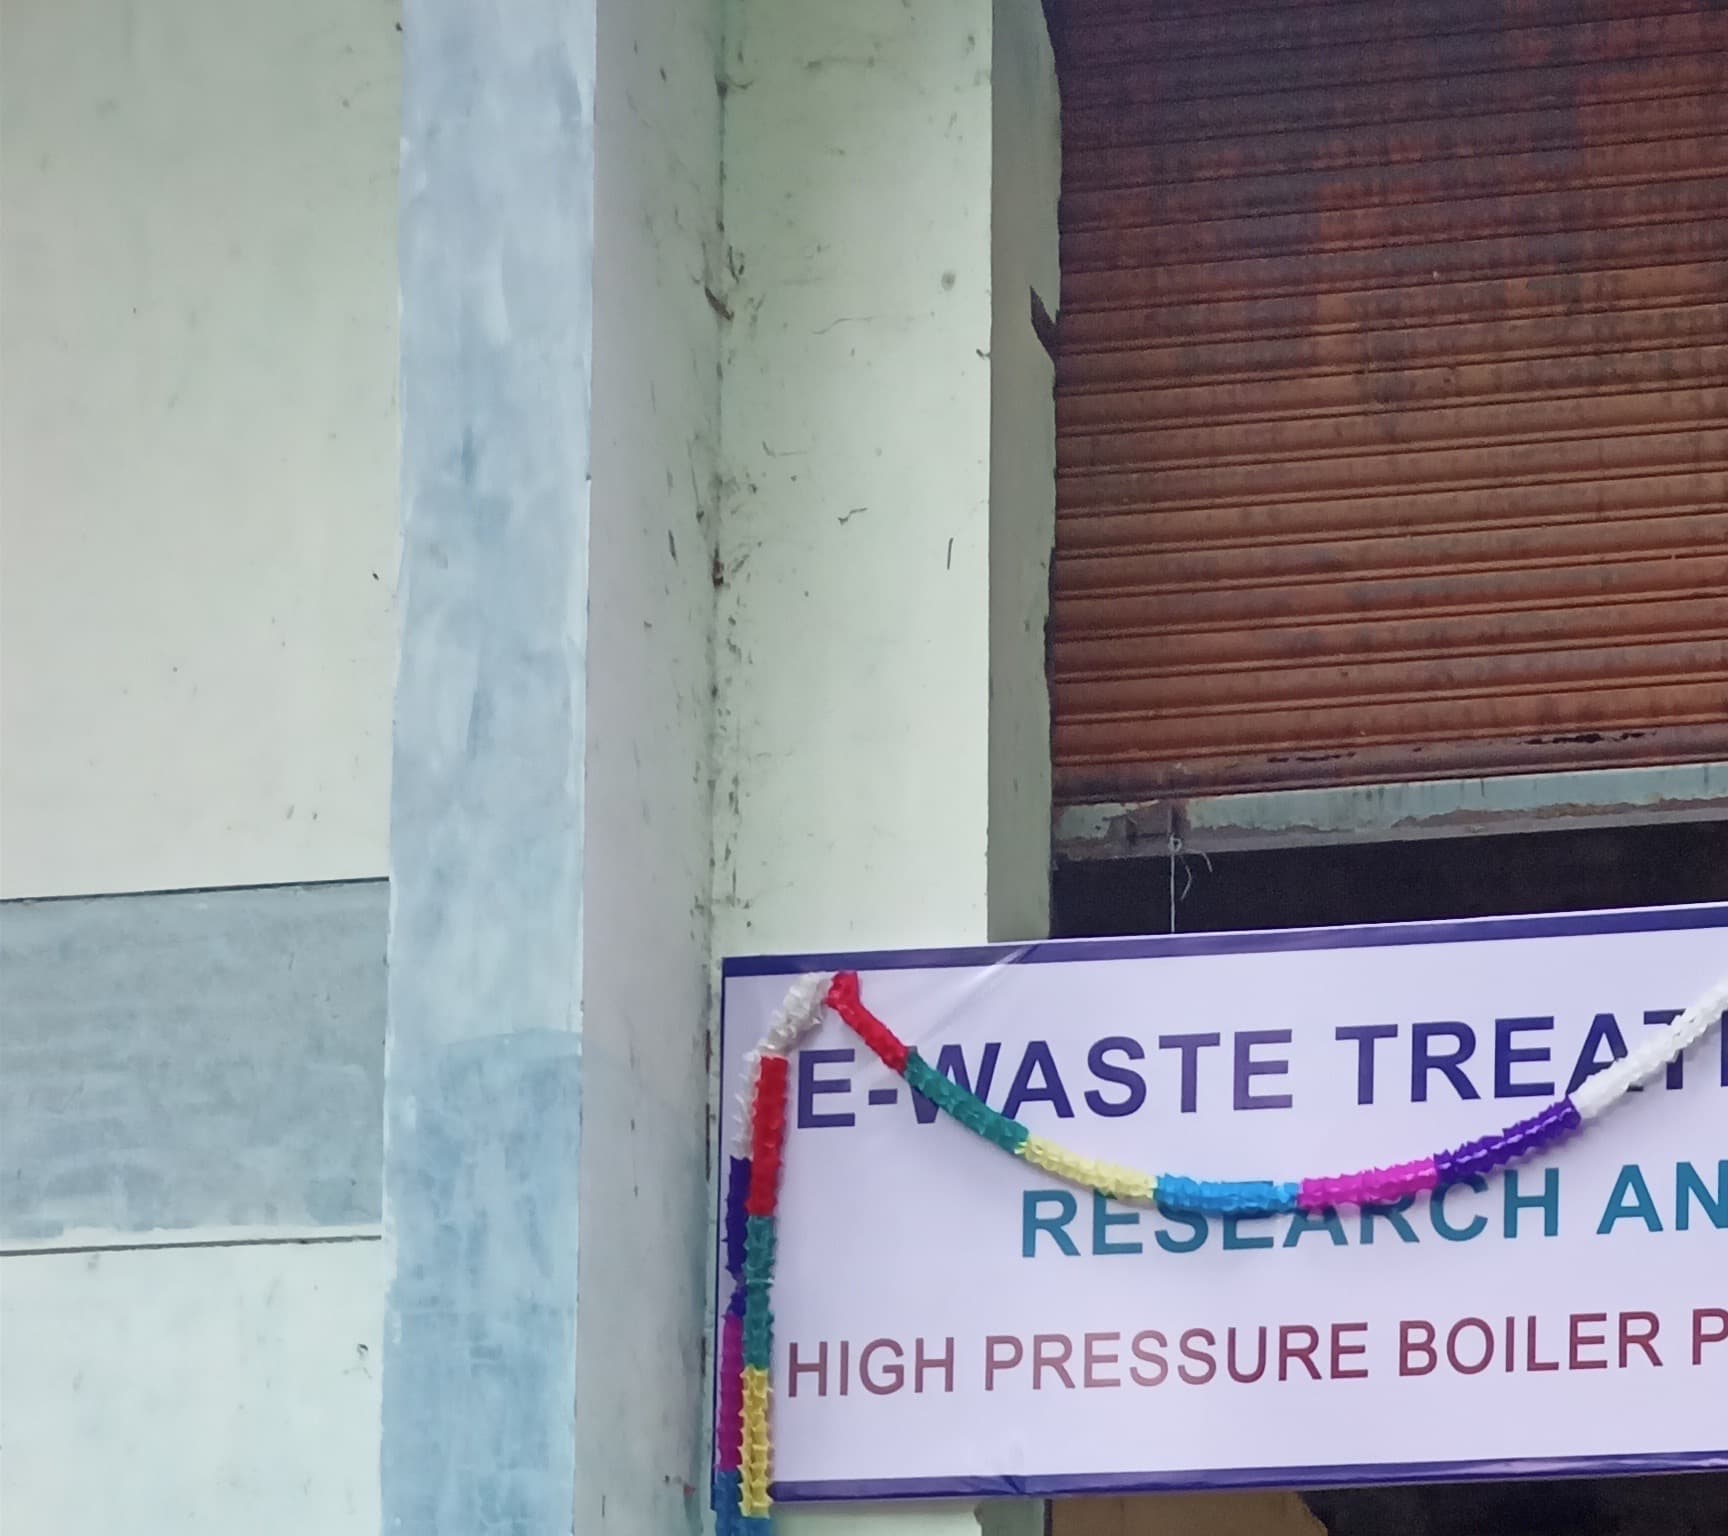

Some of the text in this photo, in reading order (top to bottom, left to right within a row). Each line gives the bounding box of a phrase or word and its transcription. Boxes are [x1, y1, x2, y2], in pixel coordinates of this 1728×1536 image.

[797, 1029, 1293, 1129] E-WASTE
[1021, 1167, 1560, 1258] RESEARCH
[787, 1337, 955, 1398] HIGH
[984, 1322, 1369, 1391] PRESSURE
[1398, 1311, 1662, 1376] BOILER
